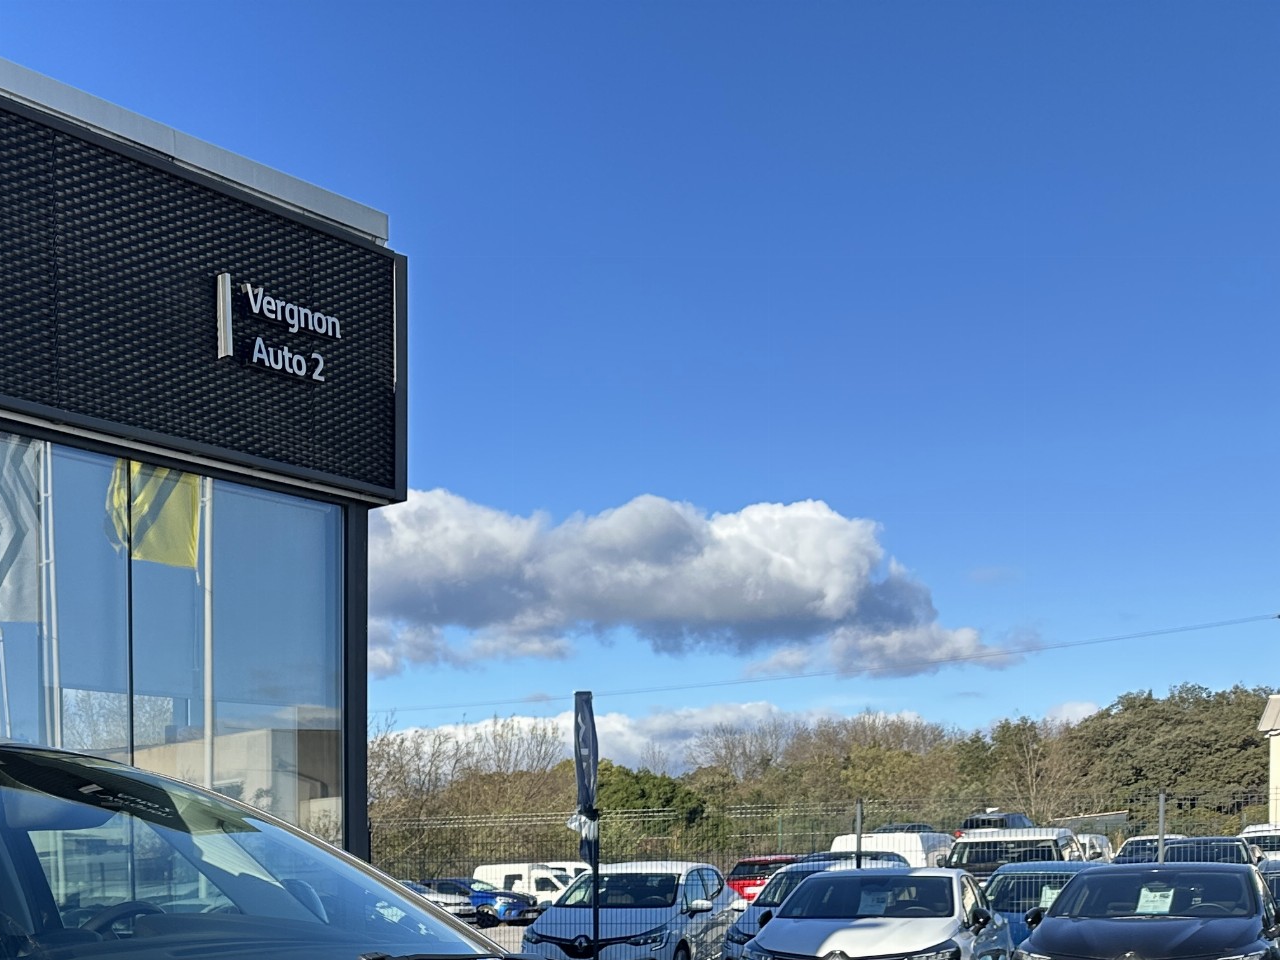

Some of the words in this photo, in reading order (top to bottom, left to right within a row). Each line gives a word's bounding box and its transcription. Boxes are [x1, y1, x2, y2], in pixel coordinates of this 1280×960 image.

[243, 283, 342, 339] Vergnon
[252, 336, 307, 377] Auto
[311, 353, 325, 382] 2
